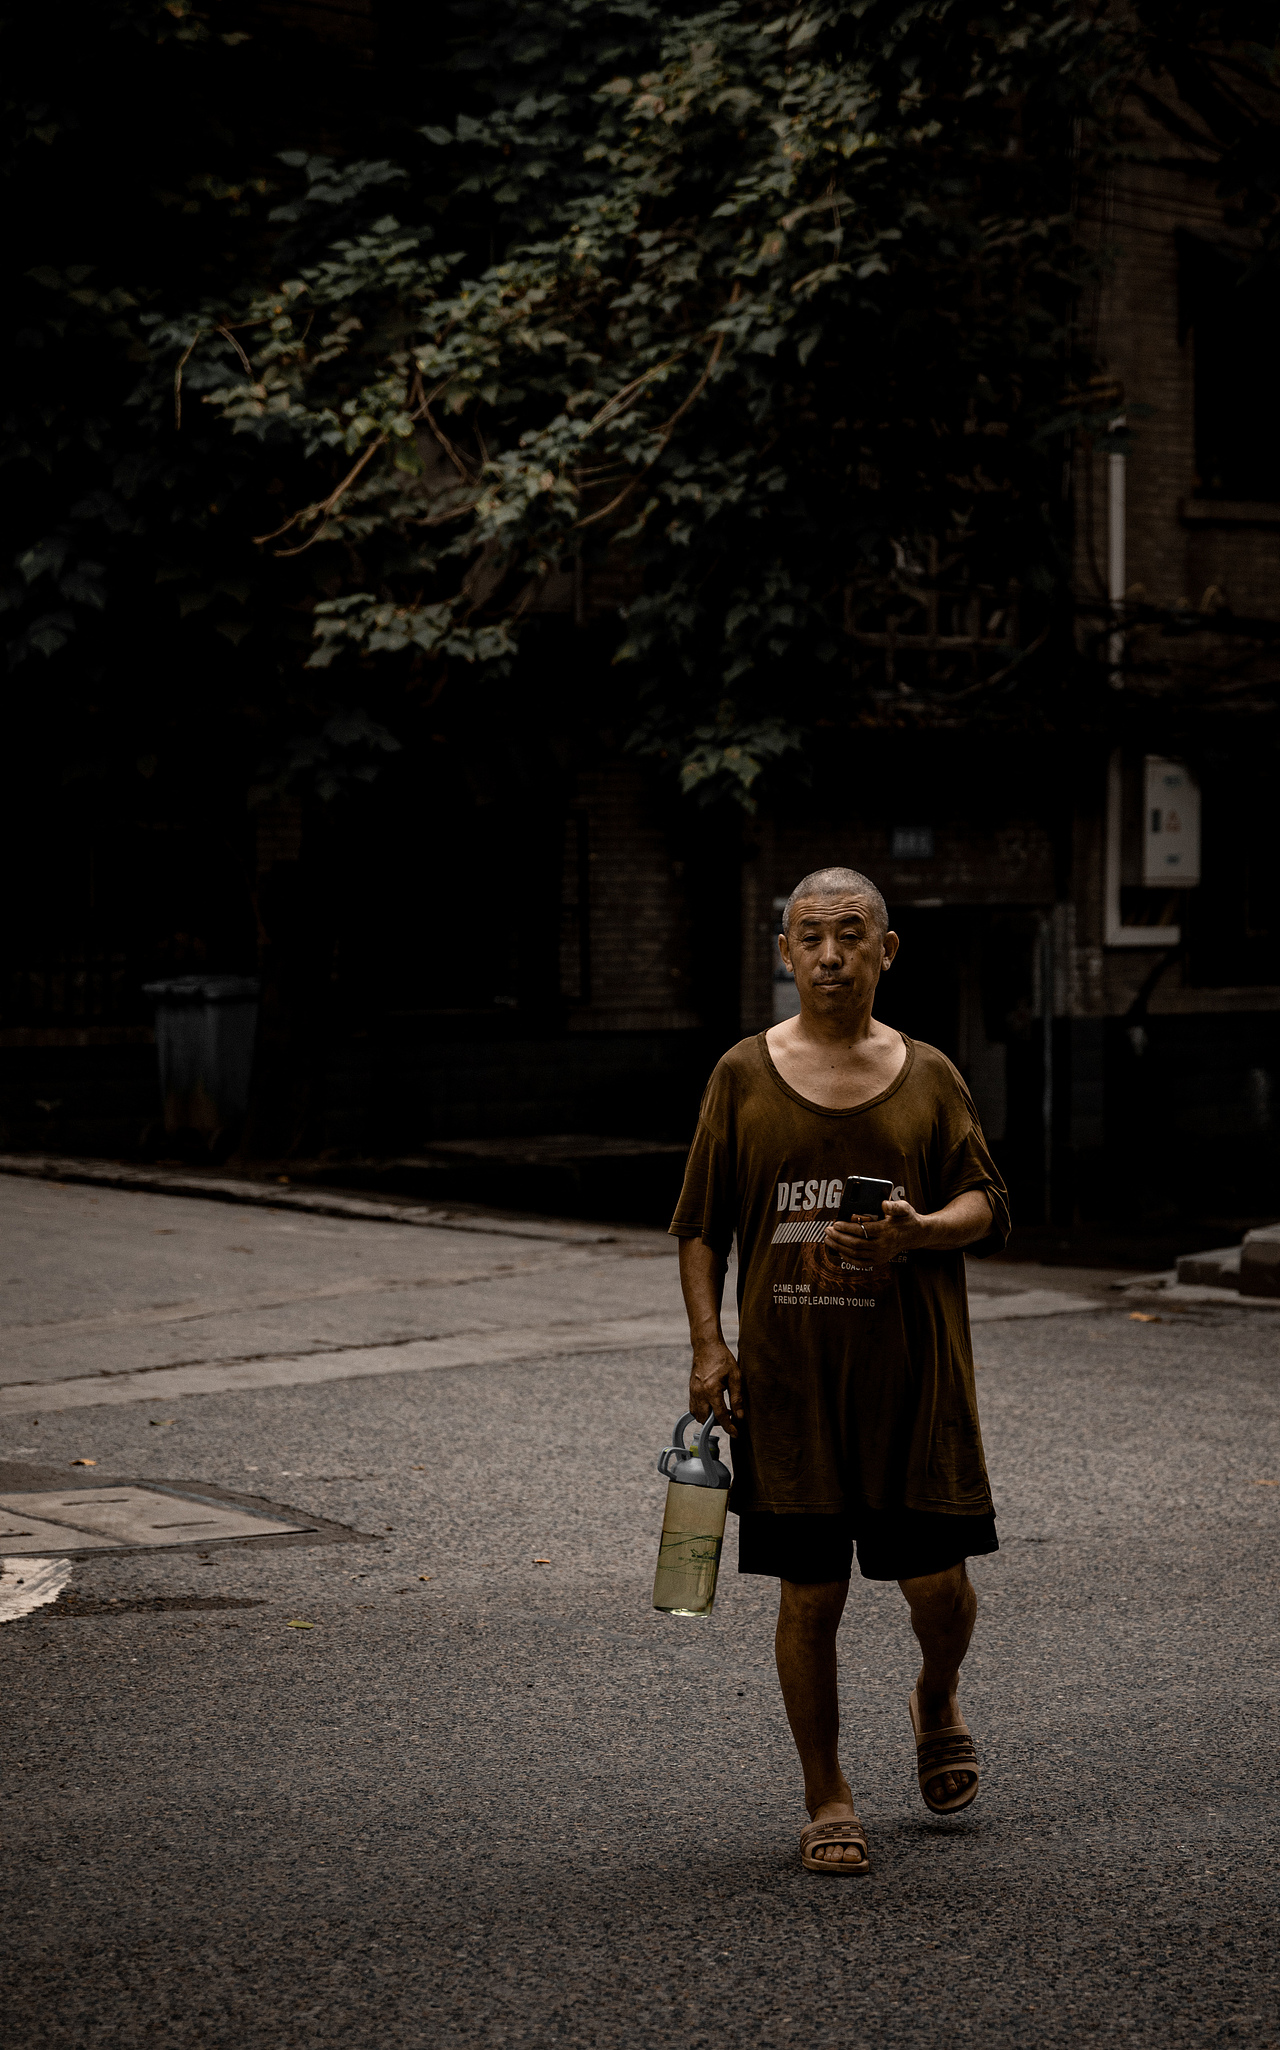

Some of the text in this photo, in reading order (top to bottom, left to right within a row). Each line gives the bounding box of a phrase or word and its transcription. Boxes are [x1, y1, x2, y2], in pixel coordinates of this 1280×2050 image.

[773, 1284, 811, 1293] CAMEL PARK
[773, 1295, 798, 1305] TREND
[846, 1297, 876, 1307] YOUNG
